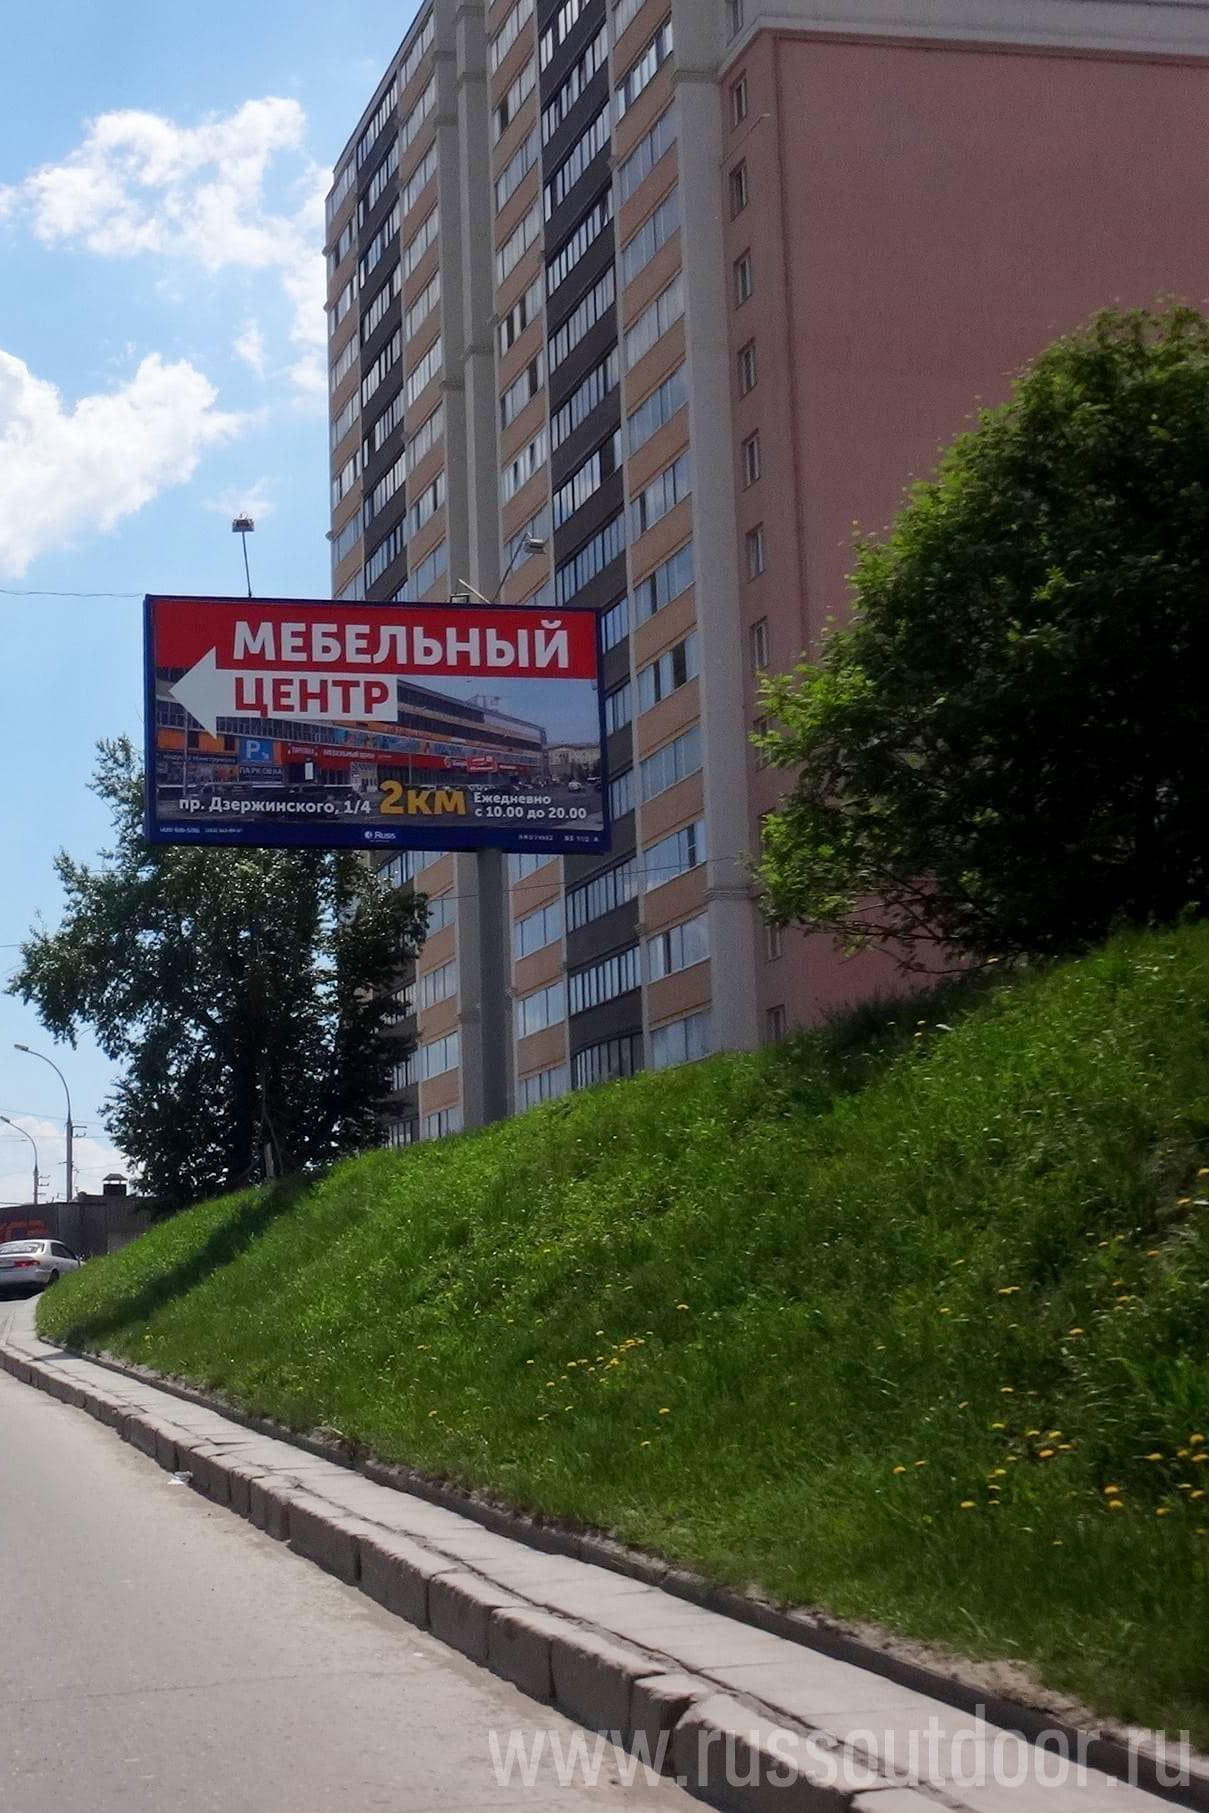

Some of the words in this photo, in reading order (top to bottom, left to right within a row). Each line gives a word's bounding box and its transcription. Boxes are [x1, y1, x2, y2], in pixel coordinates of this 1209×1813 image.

[232, 619, 569, 669] МЕБЕЛЬНЫЙ
[234, 676, 390, 717] ЦЕНТР
[179, 798, 205, 813] пр.
[209, 797, 340, 815] Дзержинского,
[344, 799, 372, 816] 1/4
[379, 780, 467, 816] 2км
[474, 792, 552, 806] Ежедневно
[475, 809, 483, 817] с
[486, 806, 524, 818] 10.00
[527, 809, 546, 819] до
[548, 807, 587, 819] 20.00
